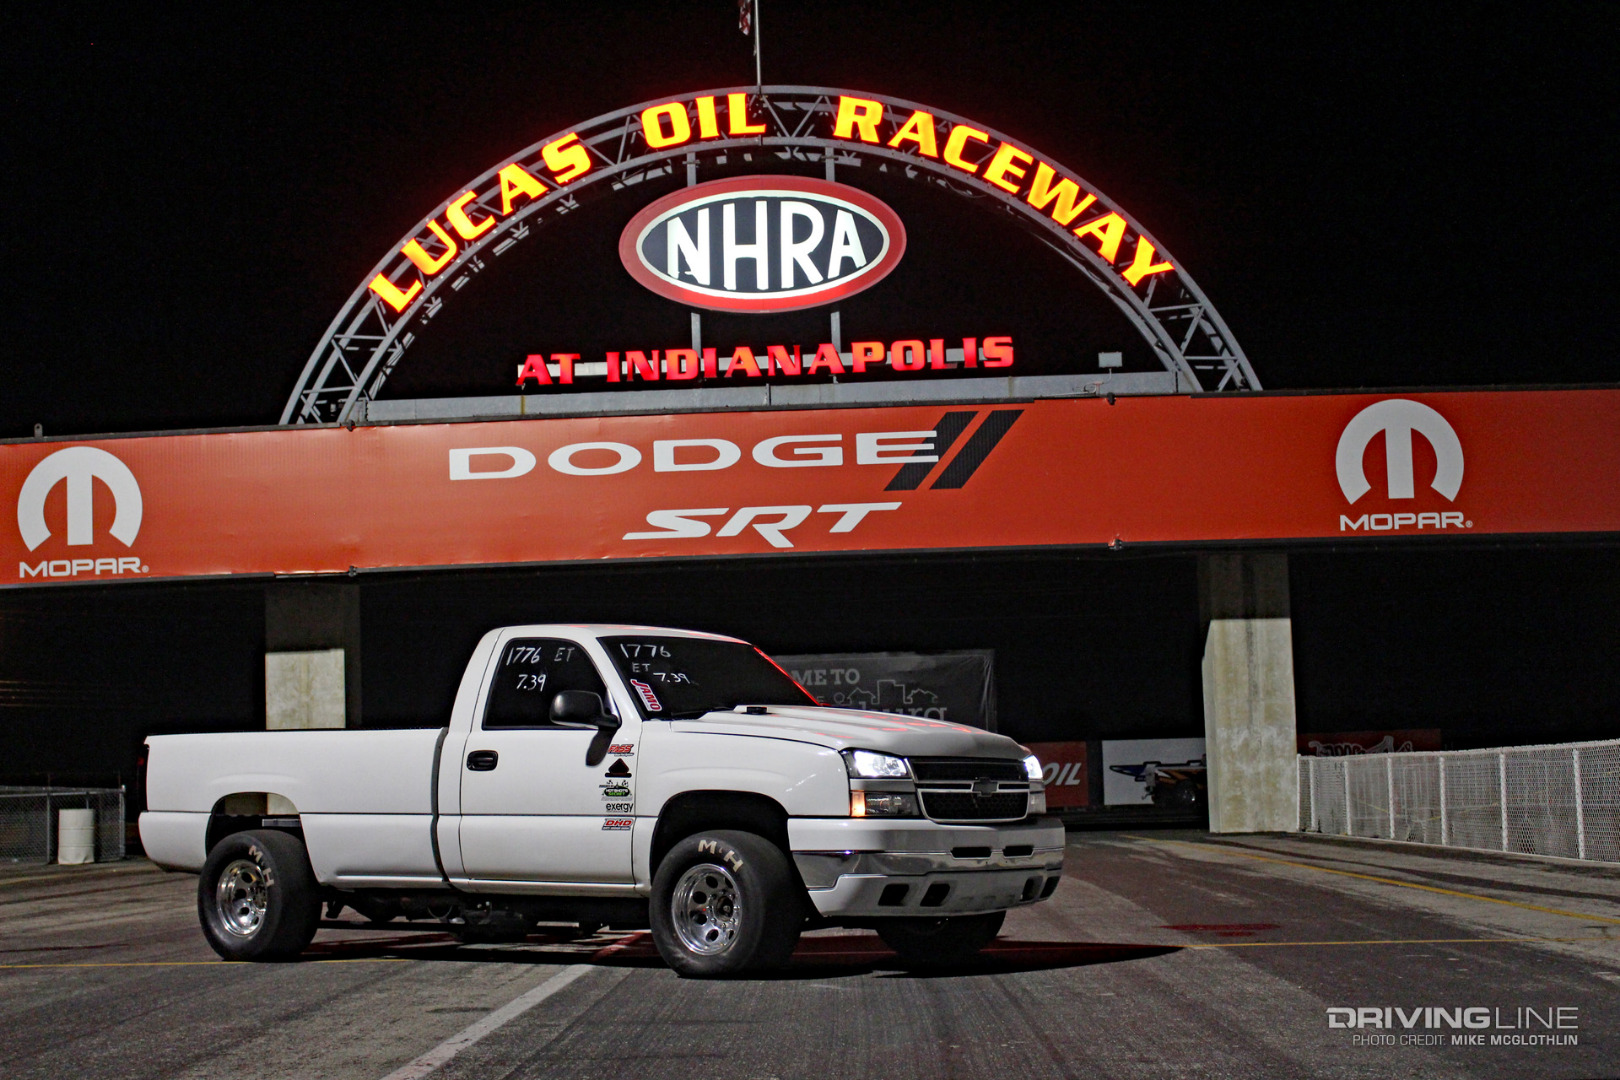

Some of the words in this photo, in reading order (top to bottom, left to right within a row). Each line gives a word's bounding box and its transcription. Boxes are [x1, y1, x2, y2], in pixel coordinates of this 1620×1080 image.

[369, 132, 591, 313] LUCAS
[641, 92, 767, 149] OIL
[833, 95, 1175, 287] RACEWAY
[667, 200, 867, 291] NHRA
[516, 353, 580, 385] AT
[606, 336, 1014, 383] INDIANAPOLIS
[449, 430, 940, 480] DODGE
[622, 501, 902, 548] SRT
[506, 646, 541, 666] 1776
[554, 647, 575, 662] ET
[620, 643, 672, 659] 1776
[632, 662, 650, 673] ET
[653, 672, 691, 684] 7.39
[830, 668, 860, 684] TO
[516, 673, 547, 692] 7.39
[630, 679, 662, 711] JAMO
[1042, 762, 1082, 787] OIL
[606, 803, 633, 813] exergy
